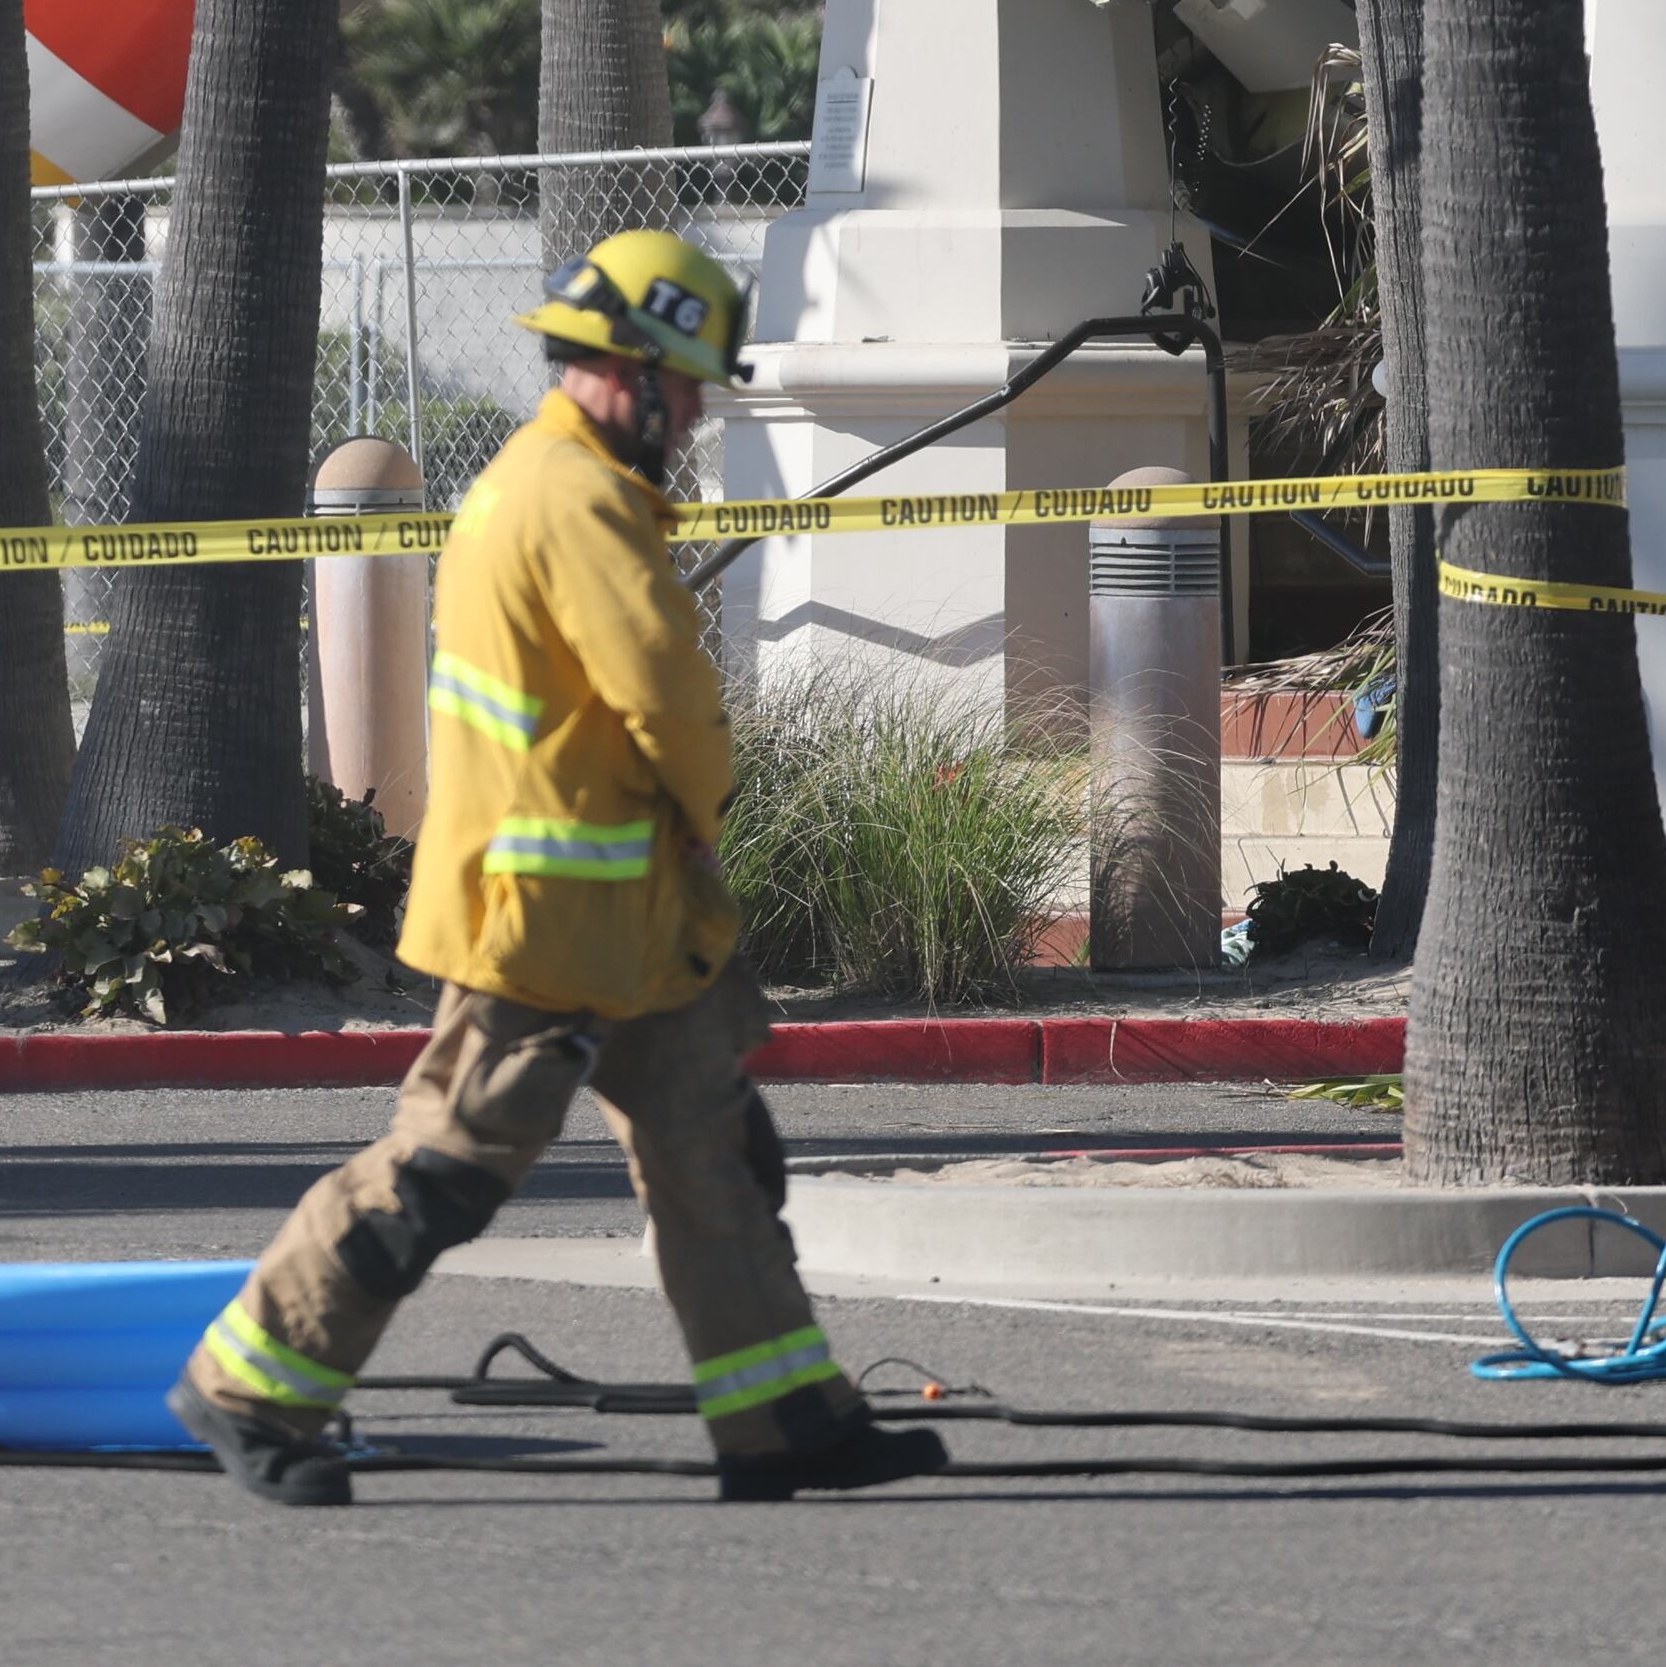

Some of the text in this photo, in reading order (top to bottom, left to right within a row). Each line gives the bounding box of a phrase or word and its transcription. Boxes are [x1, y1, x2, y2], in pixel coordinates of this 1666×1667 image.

[715, 502, 831, 534] CUIDADO
[881, 494, 999, 526] CAUTION
[1034, 487, 1153, 518] CUIDADO
[1202, 483, 1321, 509] CAUTION
[1356, 477, 1475, 500] CUIDADO
[83, 531, 199, 561] CUIDADO
[247, 523, 364, 555] CAUTION
